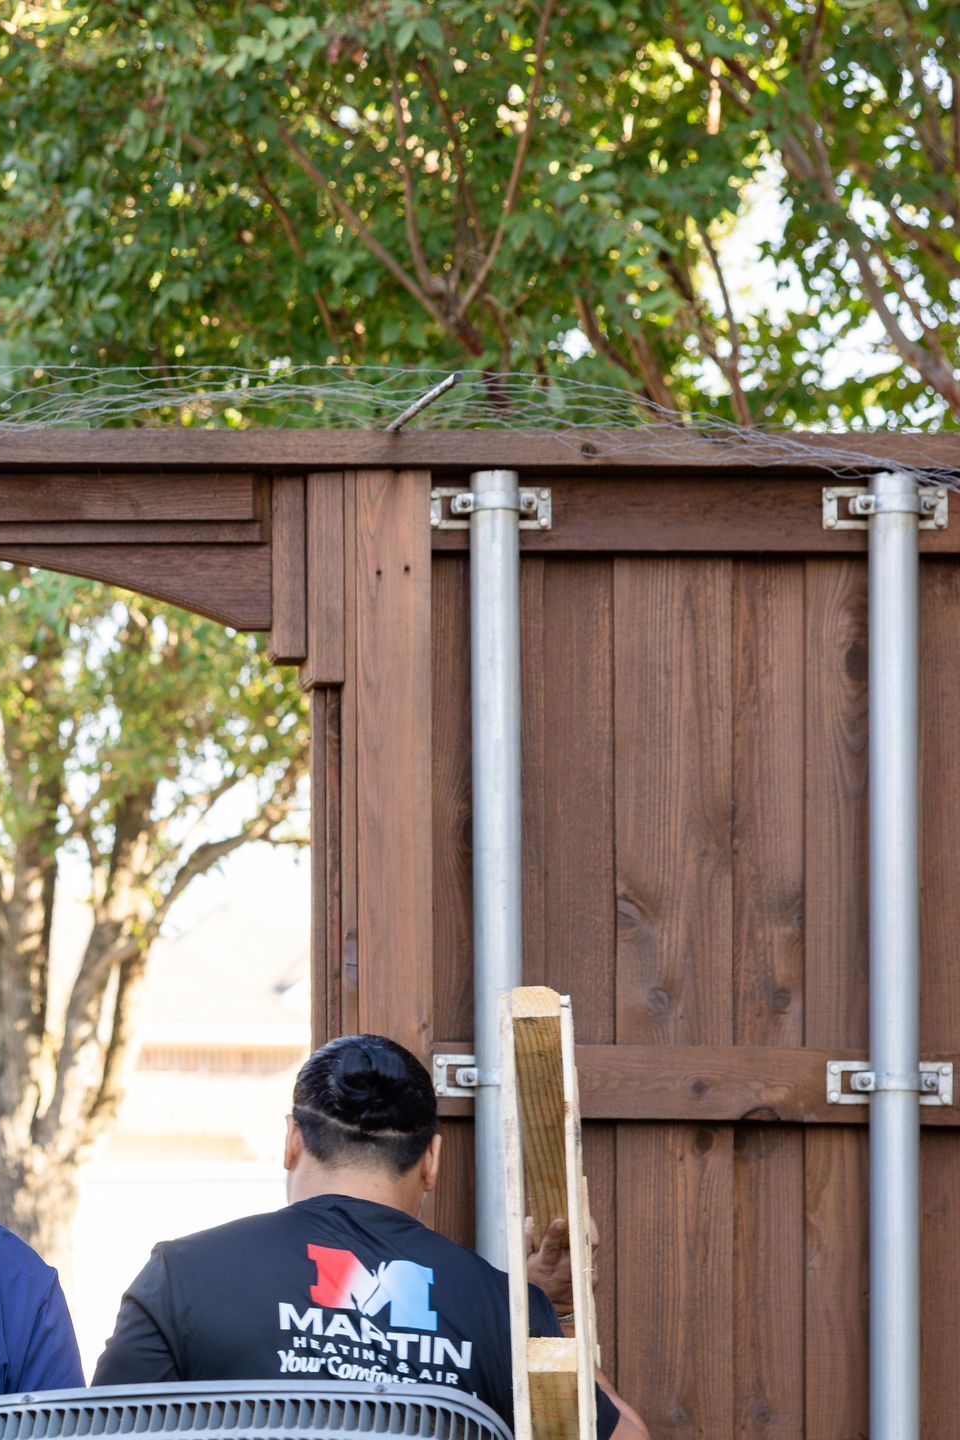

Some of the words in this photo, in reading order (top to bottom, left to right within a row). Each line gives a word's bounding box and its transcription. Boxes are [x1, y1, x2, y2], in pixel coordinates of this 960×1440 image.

[278, 1302, 473, 1370] MARTIN
[292, 1336, 388, 1366] HEATING
[395, 1361, 410, 1374] &
[418, 1368, 460, 1385] AIR
[276, 1349, 327, 1374] Your
